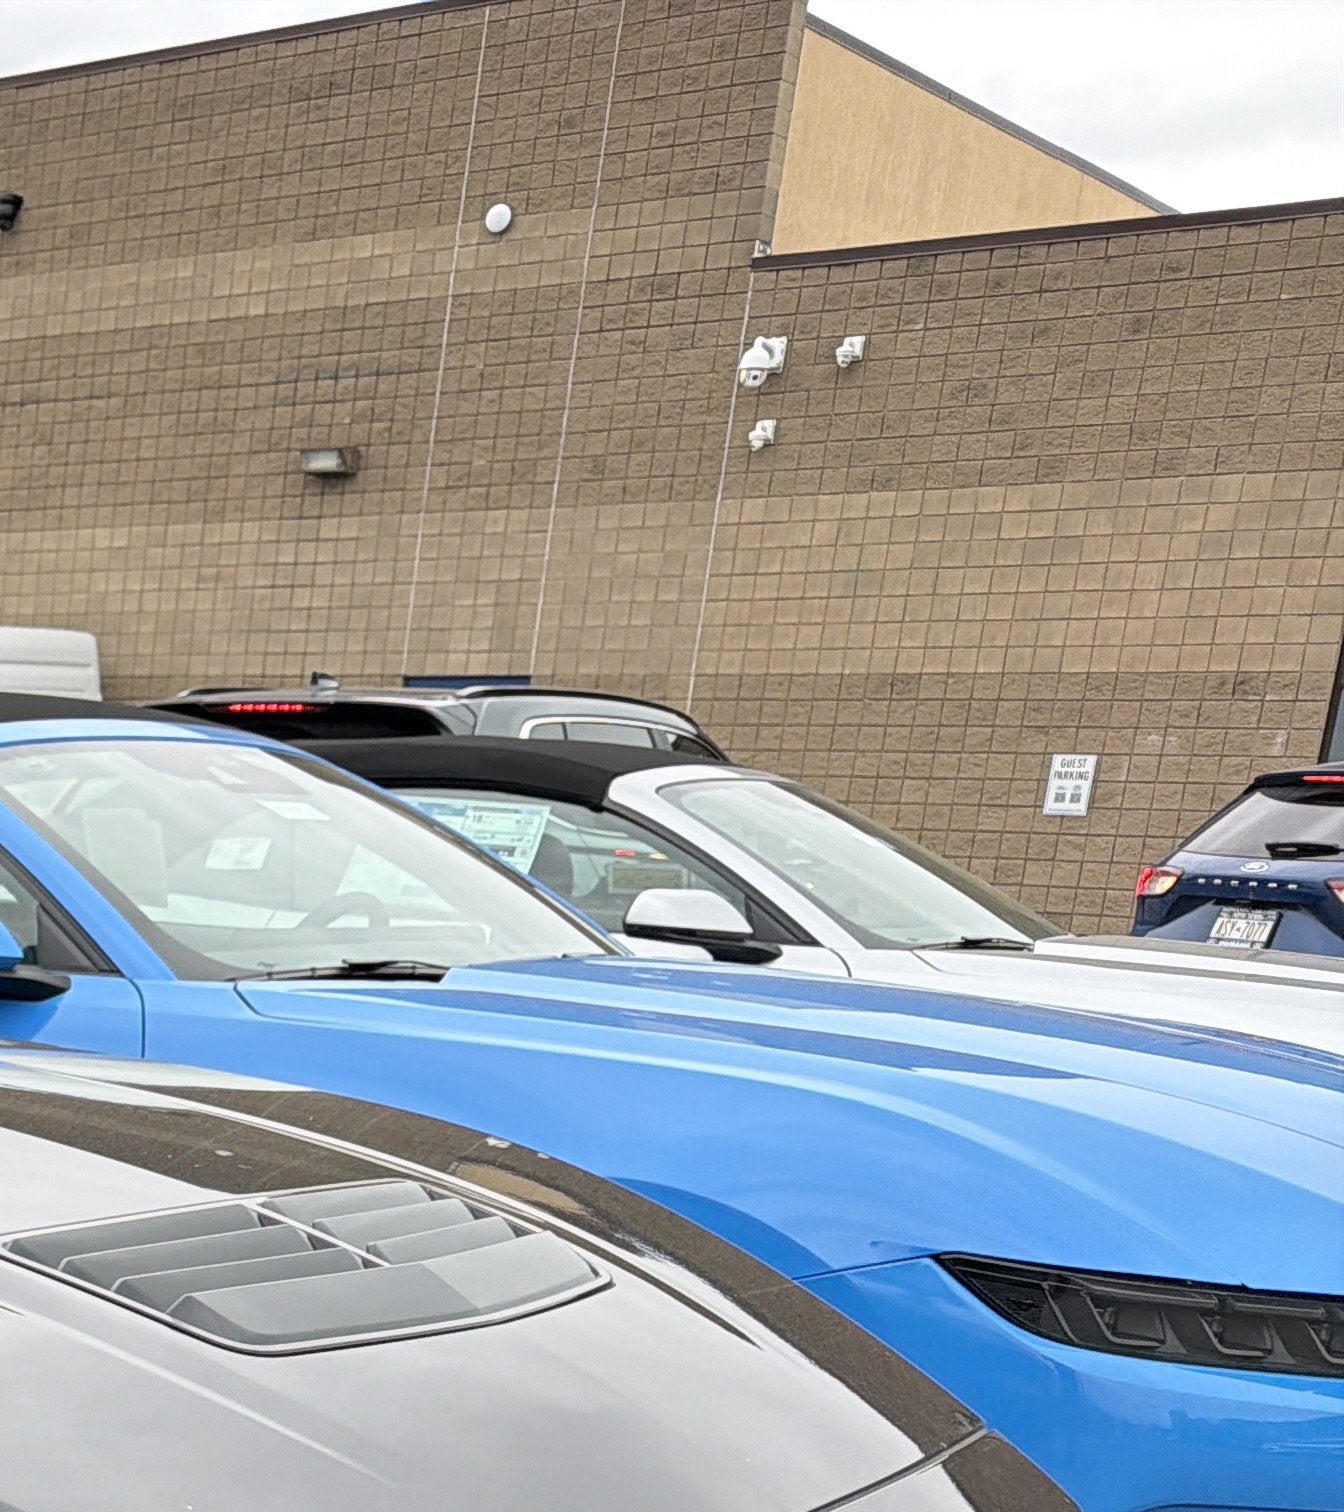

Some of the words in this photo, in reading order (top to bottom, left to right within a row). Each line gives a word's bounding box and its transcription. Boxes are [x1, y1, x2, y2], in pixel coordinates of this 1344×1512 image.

[1061, 757, 1088, 768] GUEST
[1053, 770, 1090, 782] PARKING
[1216, 920, 1237, 936] ASY
[1240, 921, 1269, 940] 7077
